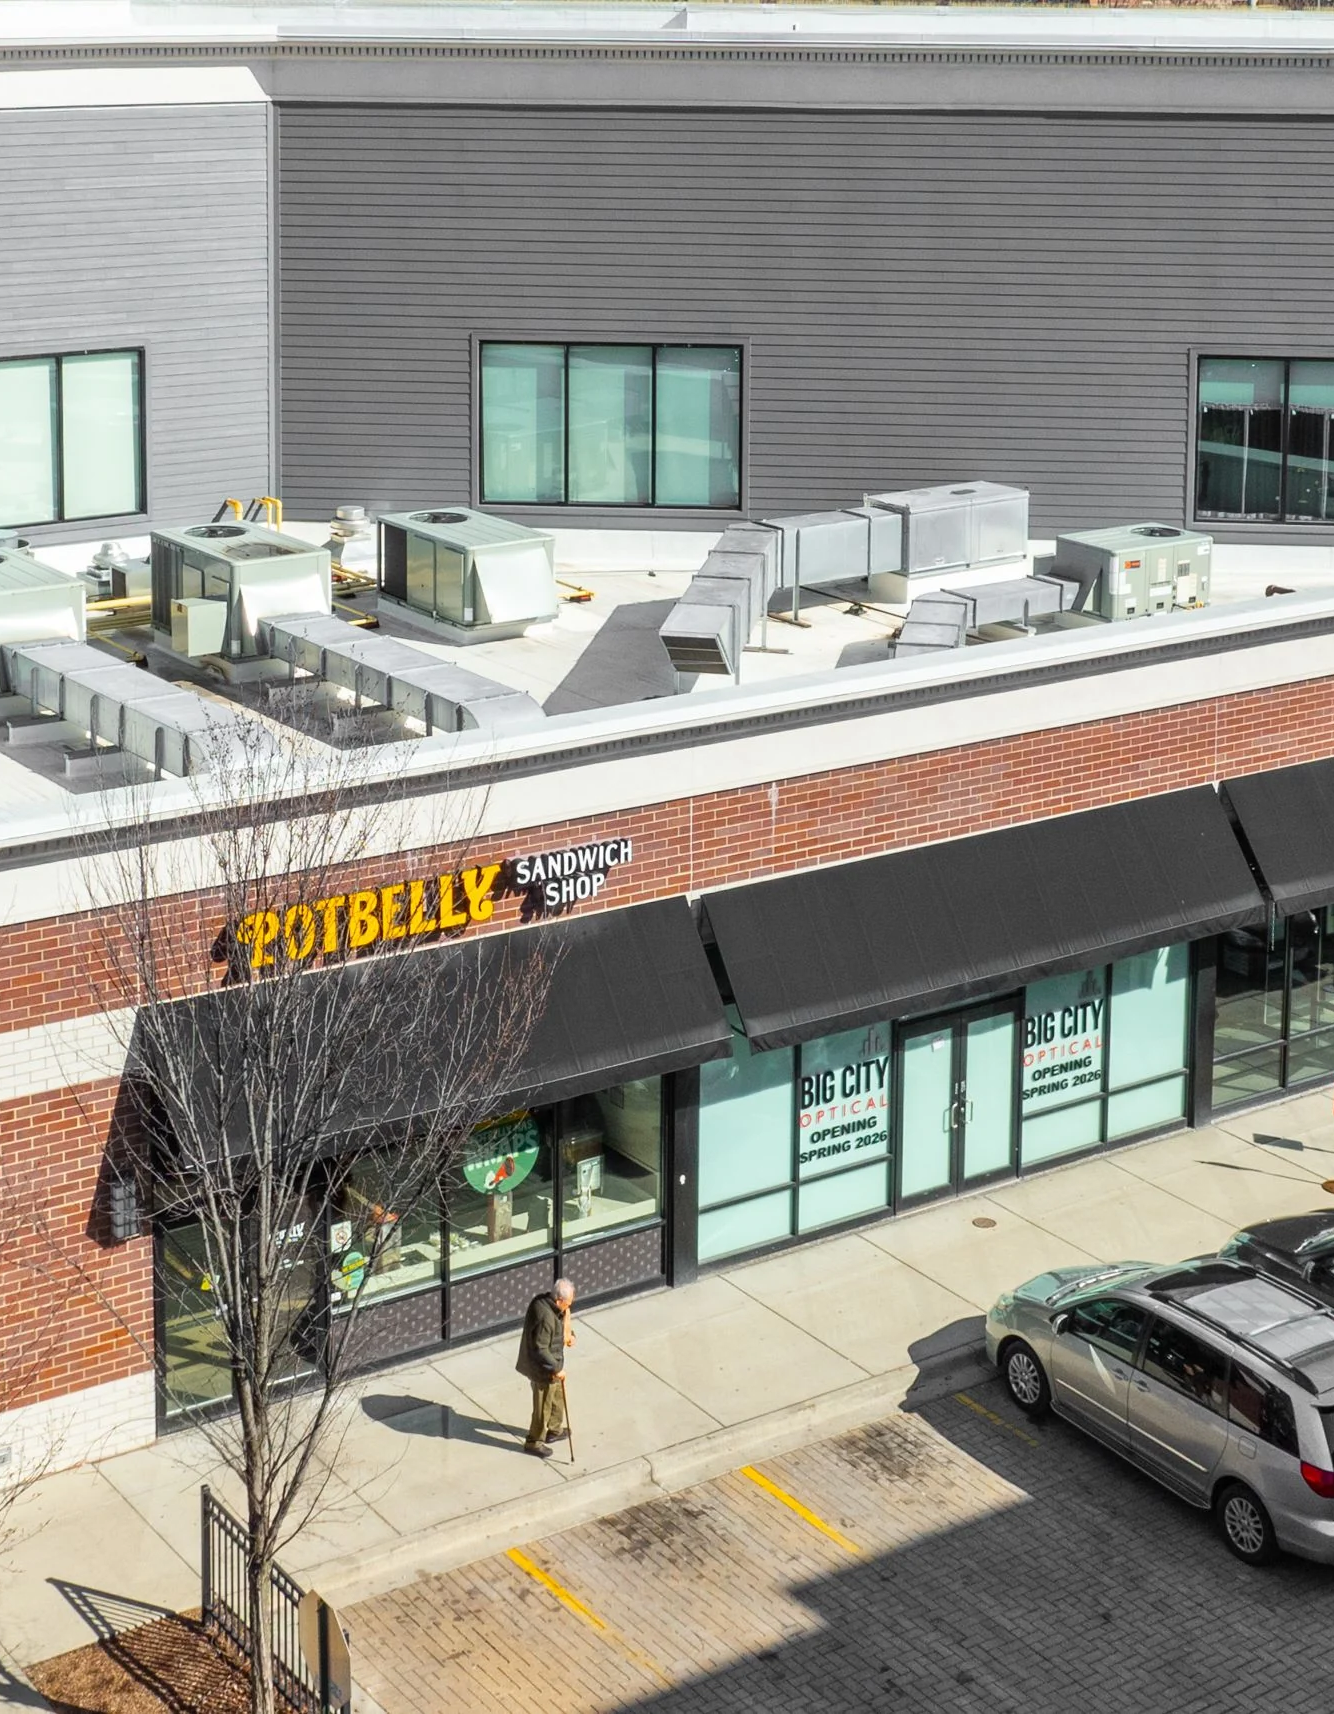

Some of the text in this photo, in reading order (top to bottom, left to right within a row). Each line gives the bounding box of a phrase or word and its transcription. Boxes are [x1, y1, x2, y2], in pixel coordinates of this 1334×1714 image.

[516, 840, 633, 886] SANDWICH
[545, 872, 606, 906] SHOP
[237, 864, 502, 968] POTBELLY
[1024, 999, 1104, 1049] BIG CITY
[1022, 1035, 1103, 1067] OPTICAL
[800, 1056, 889, 1110] BIG CITY
[1021, 1069, 1102, 1100] SPRING 2026
[1031, 1055, 1092, 1082] OPENING
[797, 1094, 890, 1128] OPTICAL
[810, 1115, 878, 1144] OPENING
[800, 1130, 888, 1164] SPRING 2026
